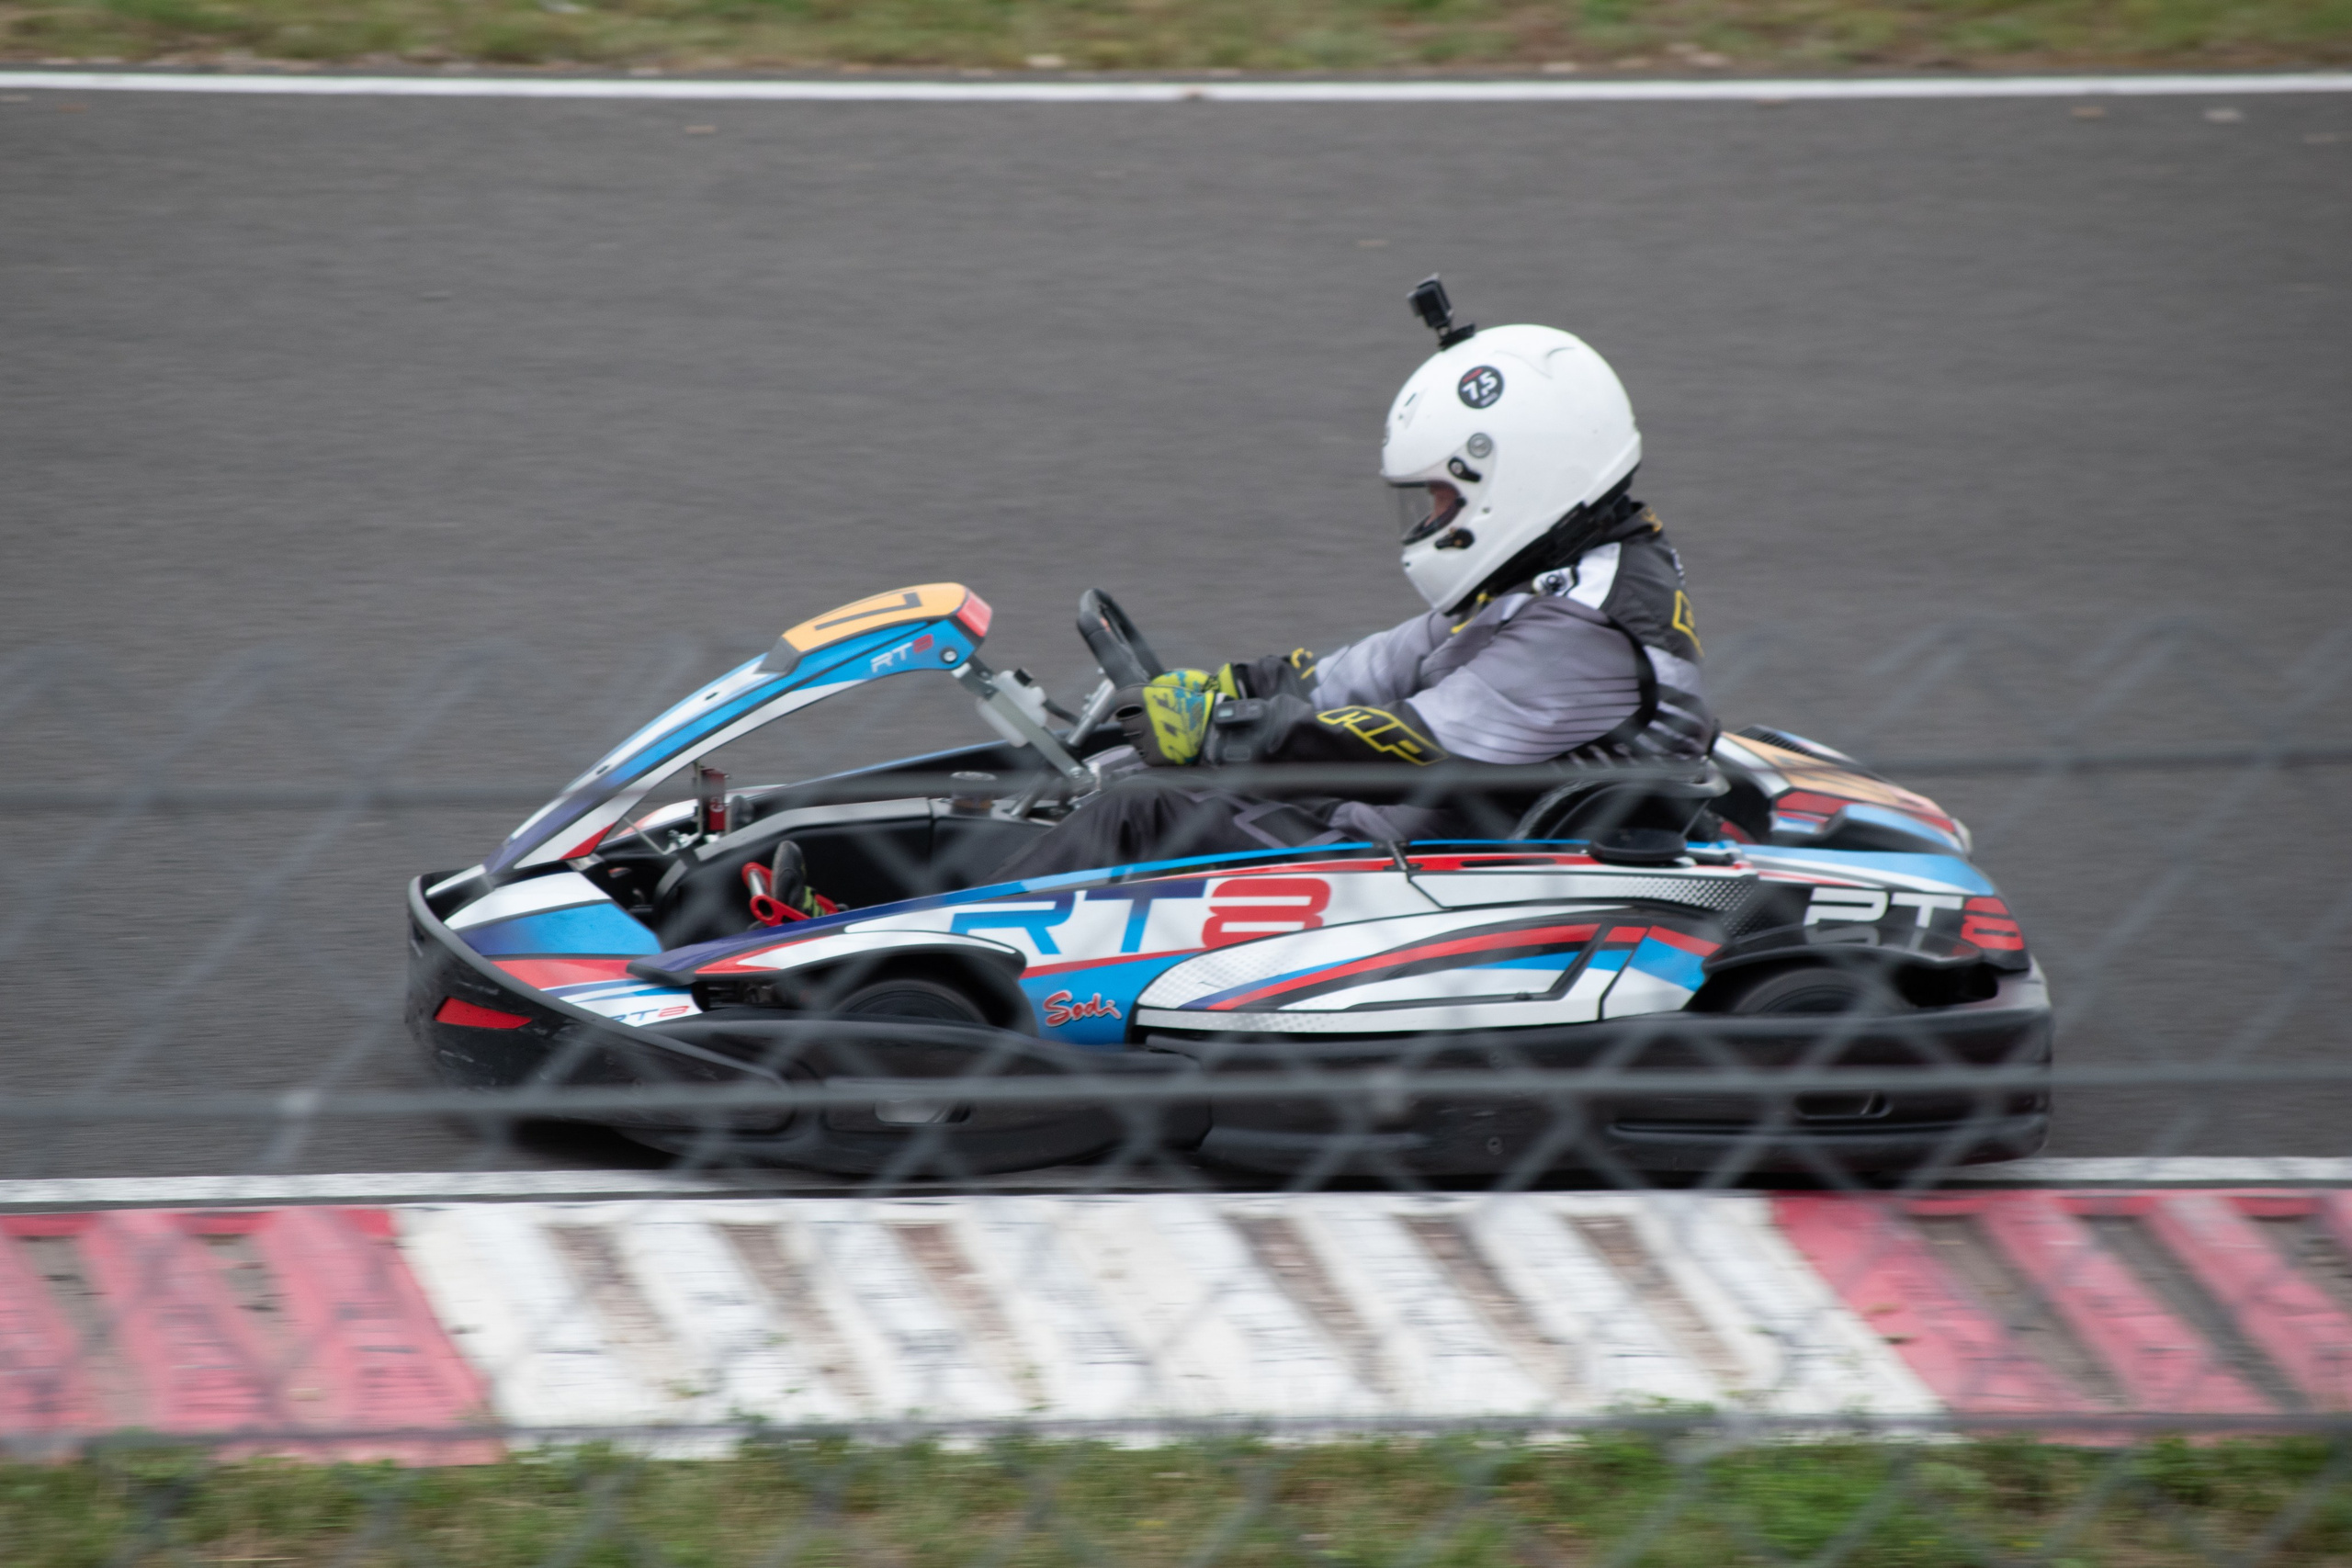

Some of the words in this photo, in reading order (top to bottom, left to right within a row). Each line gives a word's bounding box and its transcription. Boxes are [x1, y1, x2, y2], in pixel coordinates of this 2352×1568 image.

[871, 634, 934, 673] RT8
[950, 877, 1332, 955] RT8
[1043, 989, 1122, 1027] Sodi
